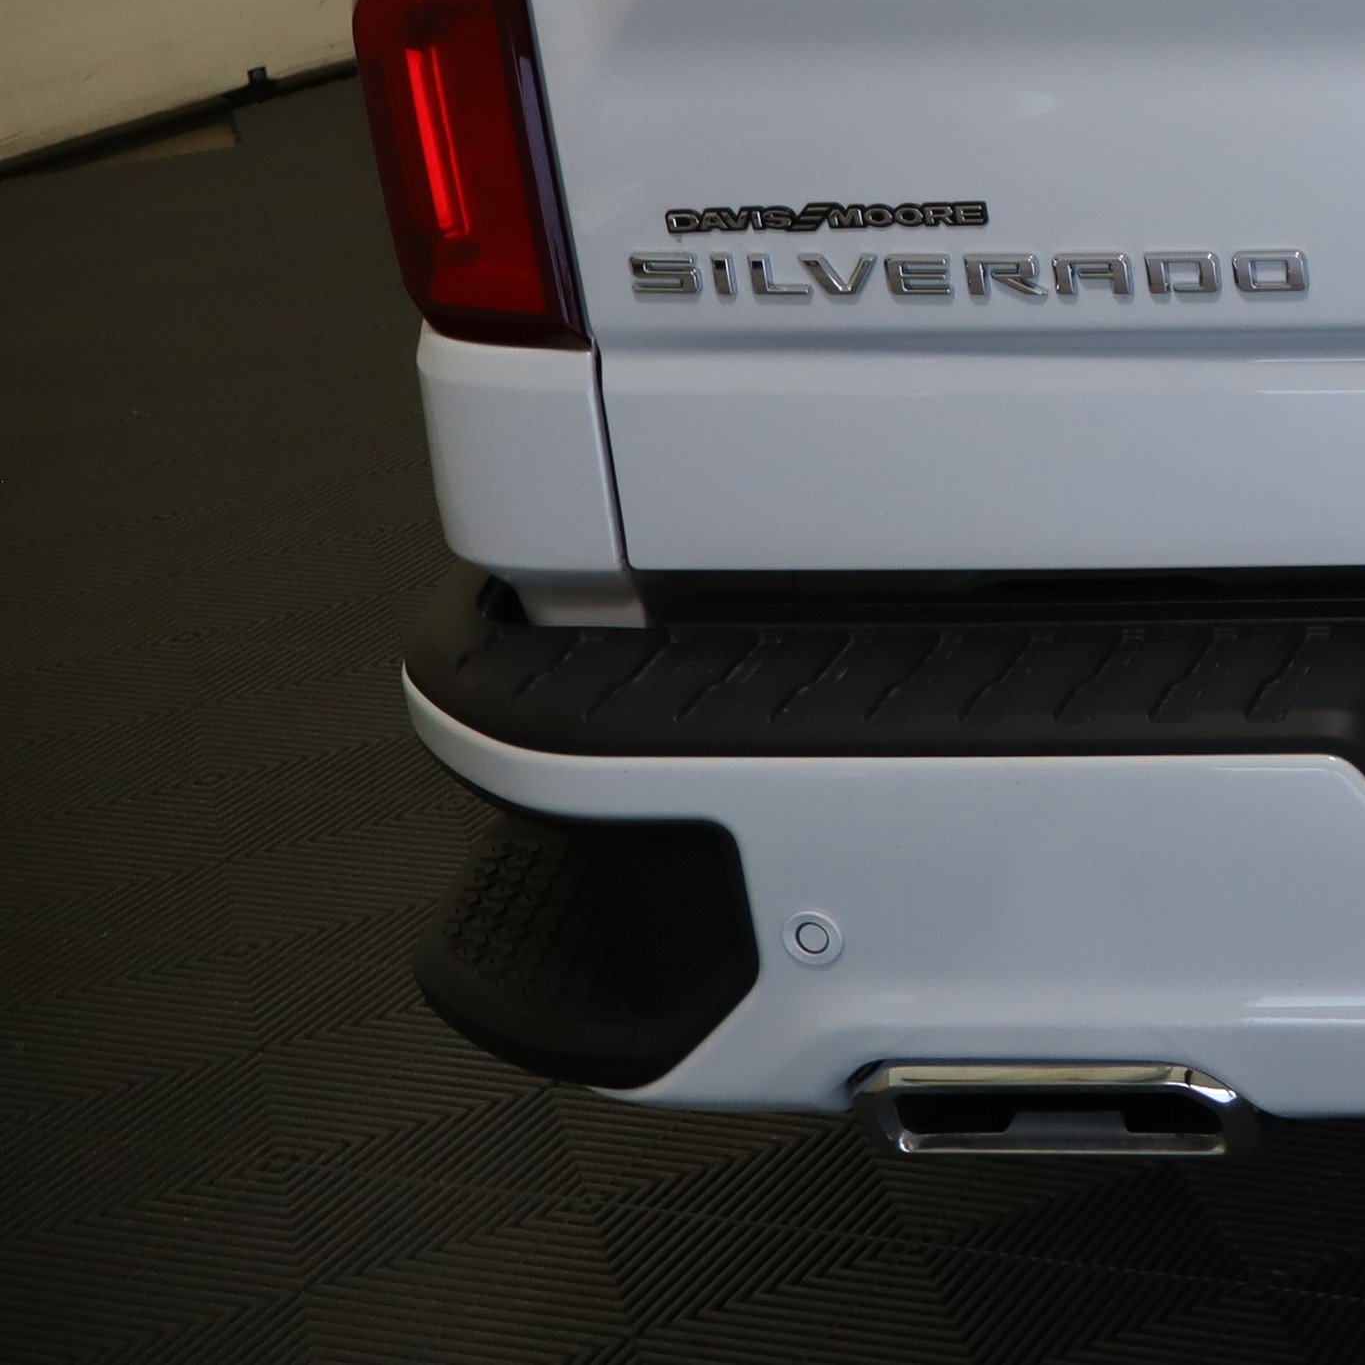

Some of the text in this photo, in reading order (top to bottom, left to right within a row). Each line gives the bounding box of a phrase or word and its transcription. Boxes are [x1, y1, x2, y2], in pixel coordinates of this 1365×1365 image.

[667, 202, 988, 233] DAVIS MOORE
[629, 252, 1308, 297] SILVERADO
